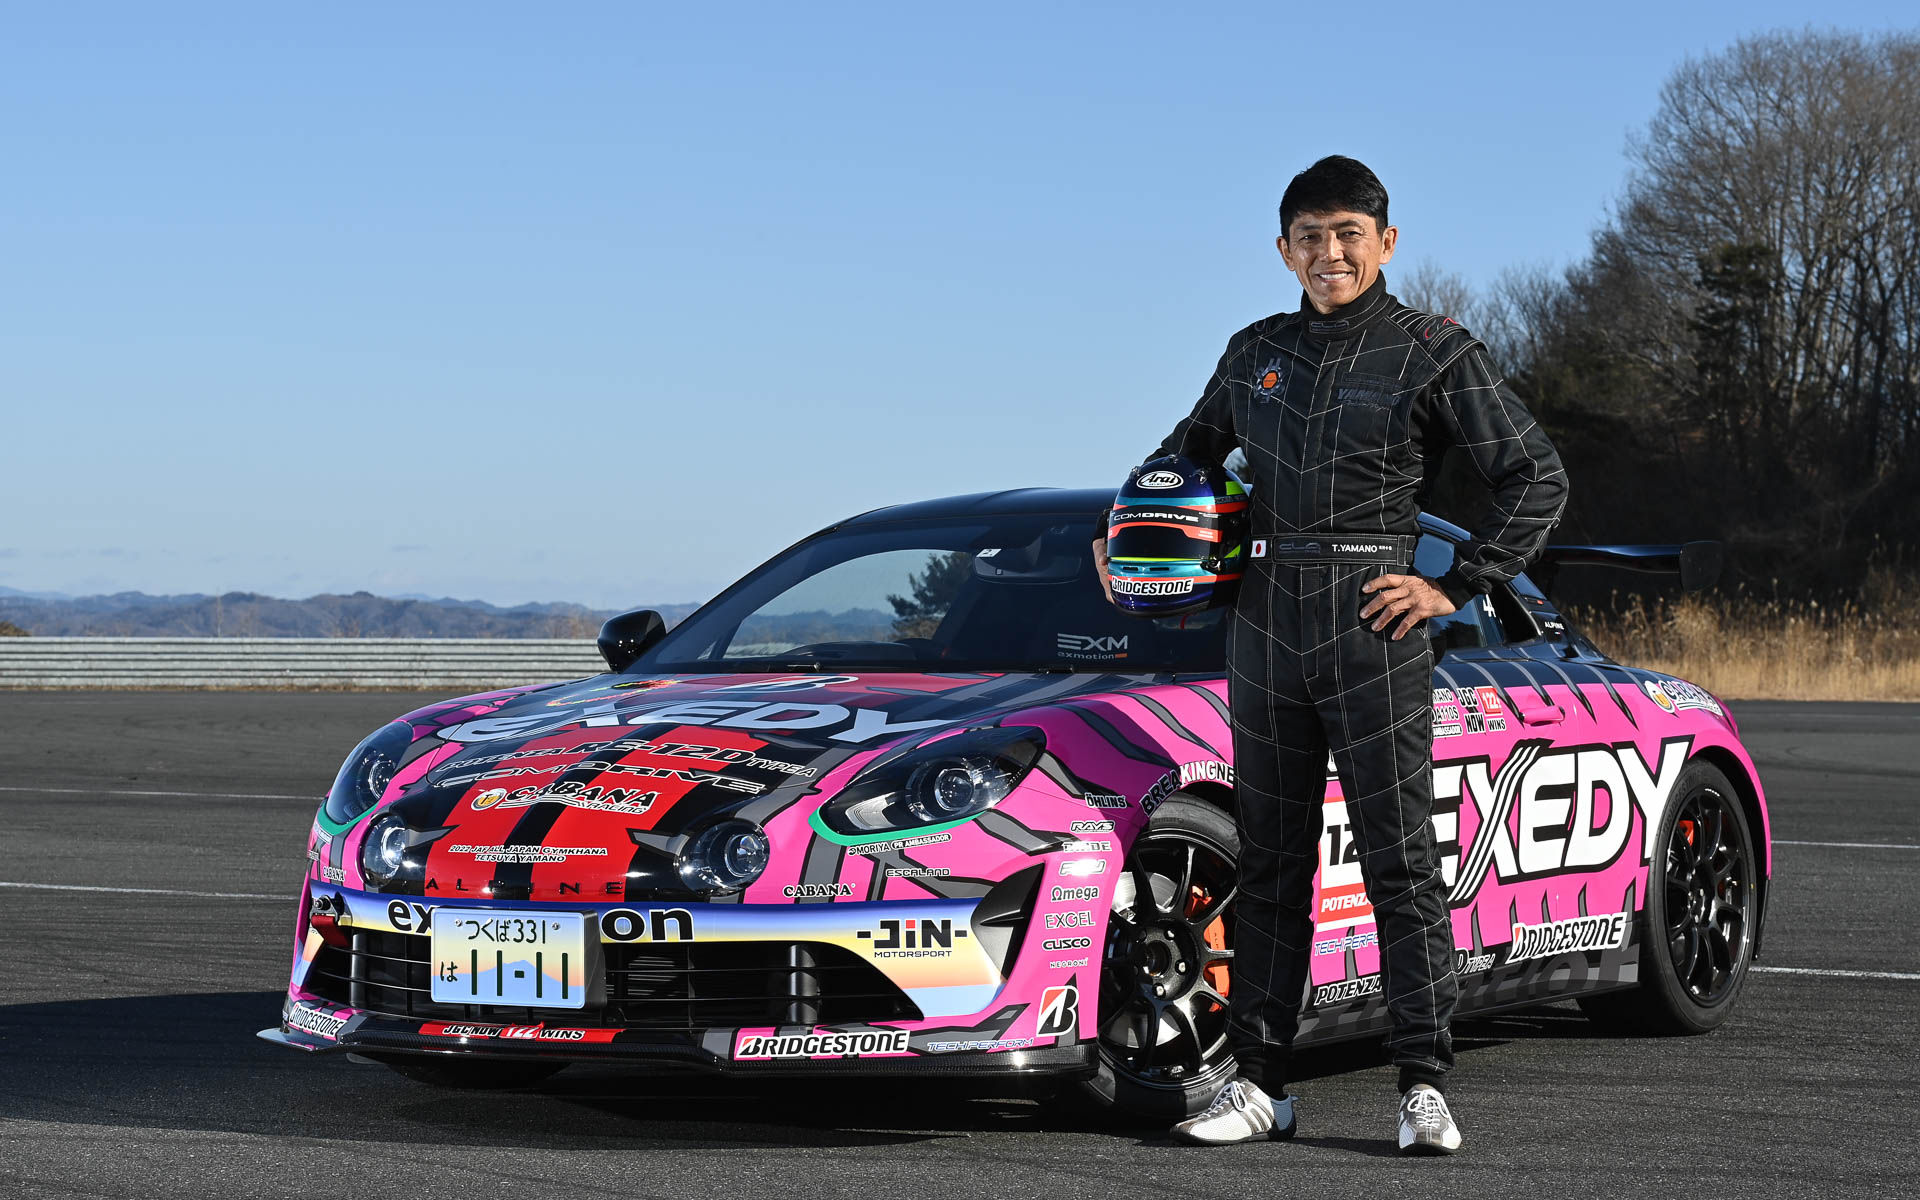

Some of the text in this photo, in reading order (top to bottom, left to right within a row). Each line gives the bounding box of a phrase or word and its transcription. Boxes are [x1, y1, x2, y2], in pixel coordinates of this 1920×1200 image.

[1141, 473, 1177, 483] Arai
[1114, 512, 1199, 523] COMDRIVE
[1332, 544, 1377, 553] T.YAMANO
[1112, 576, 1193, 595] BRIDGESTONE
[1057, 651, 1114, 660] exmotion
[1457, 687, 1478, 707] JGC
[437, 699, 962, 744] EXEDY
[1464, 713, 1486, 733] NOW
[1487, 719, 1506, 731] WINS
[565, 738, 757, 764] RE-12D
[434, 760, 767, 794] COMDRIVE
[505, 782, 661, 807] CABANA
[1085, 793, 1127, 808] ÖHLINS
[1071, 821, 1114, 832] RAYS
[1433, 738, 1692, 901] EXEDY
[449, 845, 471, 853] 2022
[506, 845, 540, 854] JAPAN
[541, 846, 608, 856] GYMKHANA
[856, 842, 891, 855] MORIYA
[904, 835, 949, 847] AMBASSADOR
[475, 854, 566, 863] TETSUYA YAMANO
[886, 868, 950, 878] ESCALAND
[783, 884, 852, 898] CABANA
[1043, 938, 1091, 950] CUSCO
[1508, 912, 1627, 964] BRIDGESTONE
[873, 950, 952, 959] MOTORSPORT
[440, 949, 569, 999] は 11-11
[1313, 974, 1382, 1006] POTENZA
[290, 1003, 344, 1036] BRIDGESTONE
[442, 1025, 470, 1036] JGC
[470, 1025, 501, 1037] NOW
[540, 1028, 586, 1040] WINS
[737, 1030, 909, 1057] BRIDGESTONE
